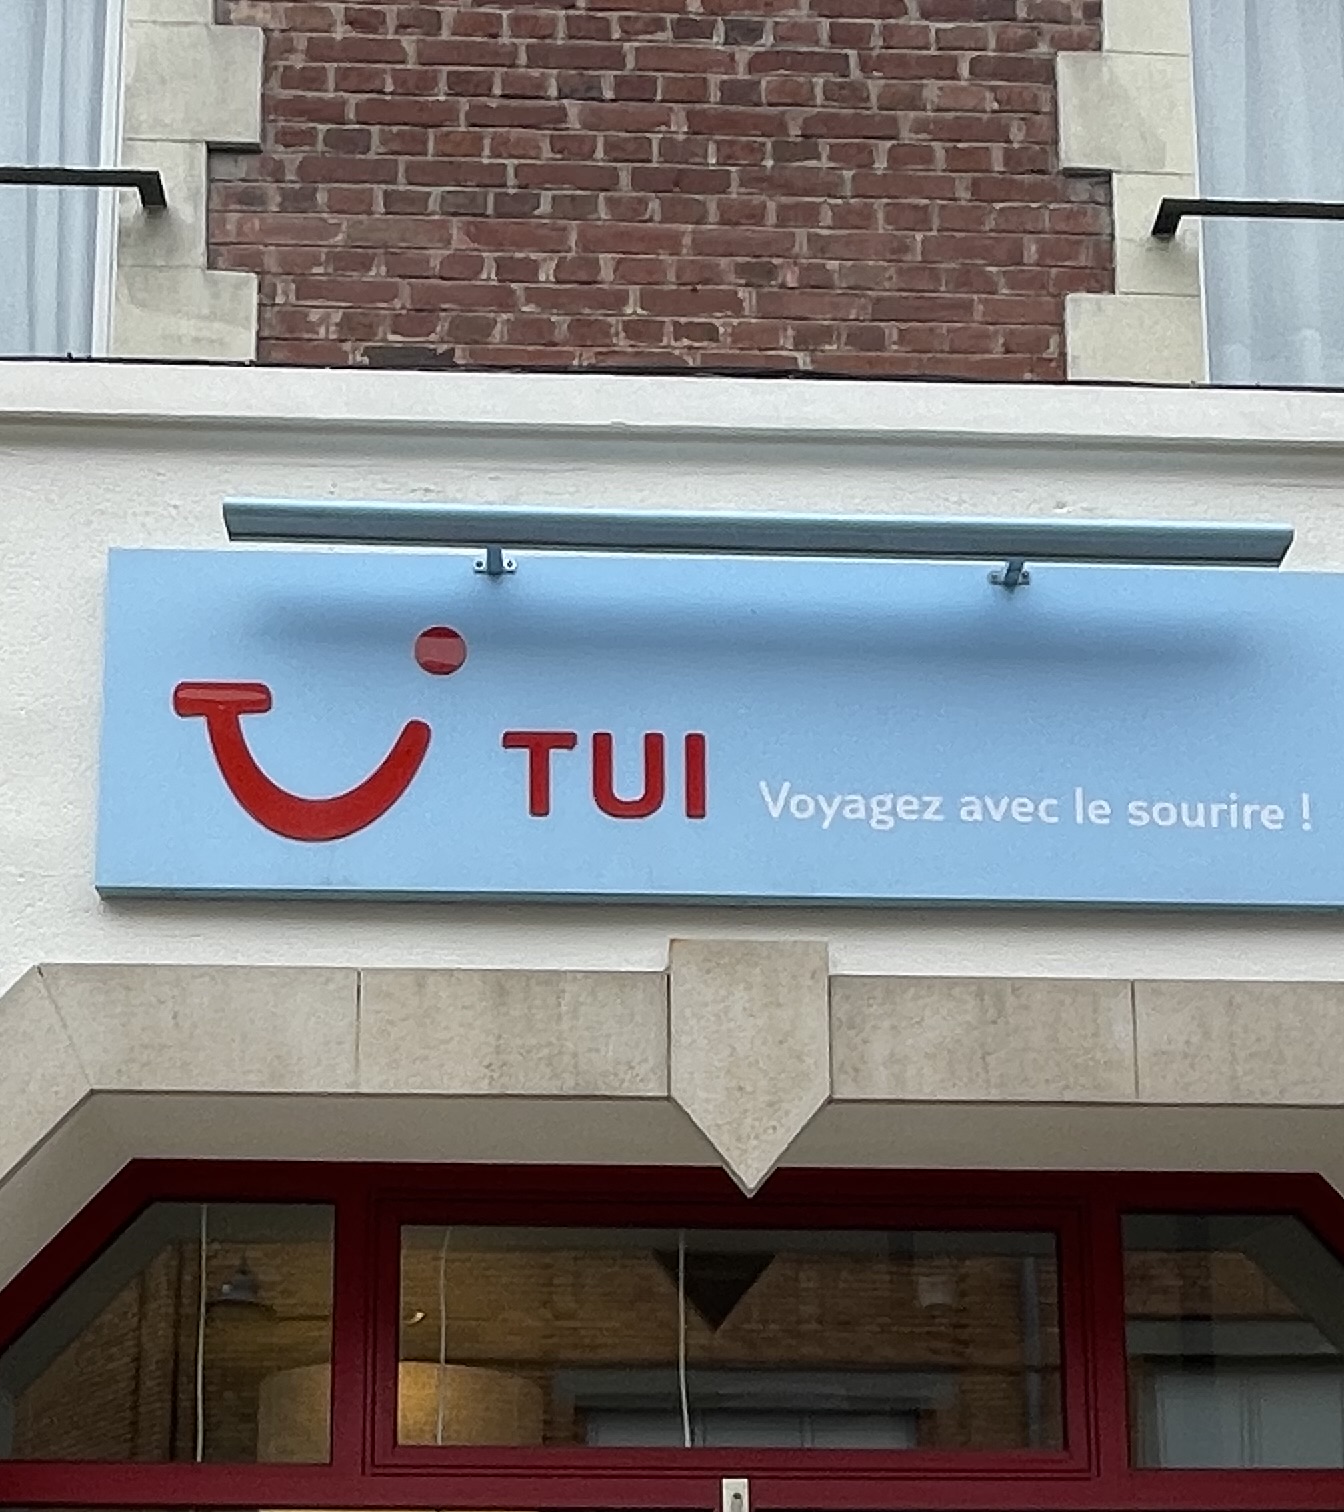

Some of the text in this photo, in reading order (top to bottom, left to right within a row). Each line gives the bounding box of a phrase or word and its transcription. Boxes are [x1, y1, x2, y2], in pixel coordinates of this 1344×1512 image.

[502, 731, 705, 819] TUI
[759, 780, 1313, 831] Voyagez avec le sourire !
